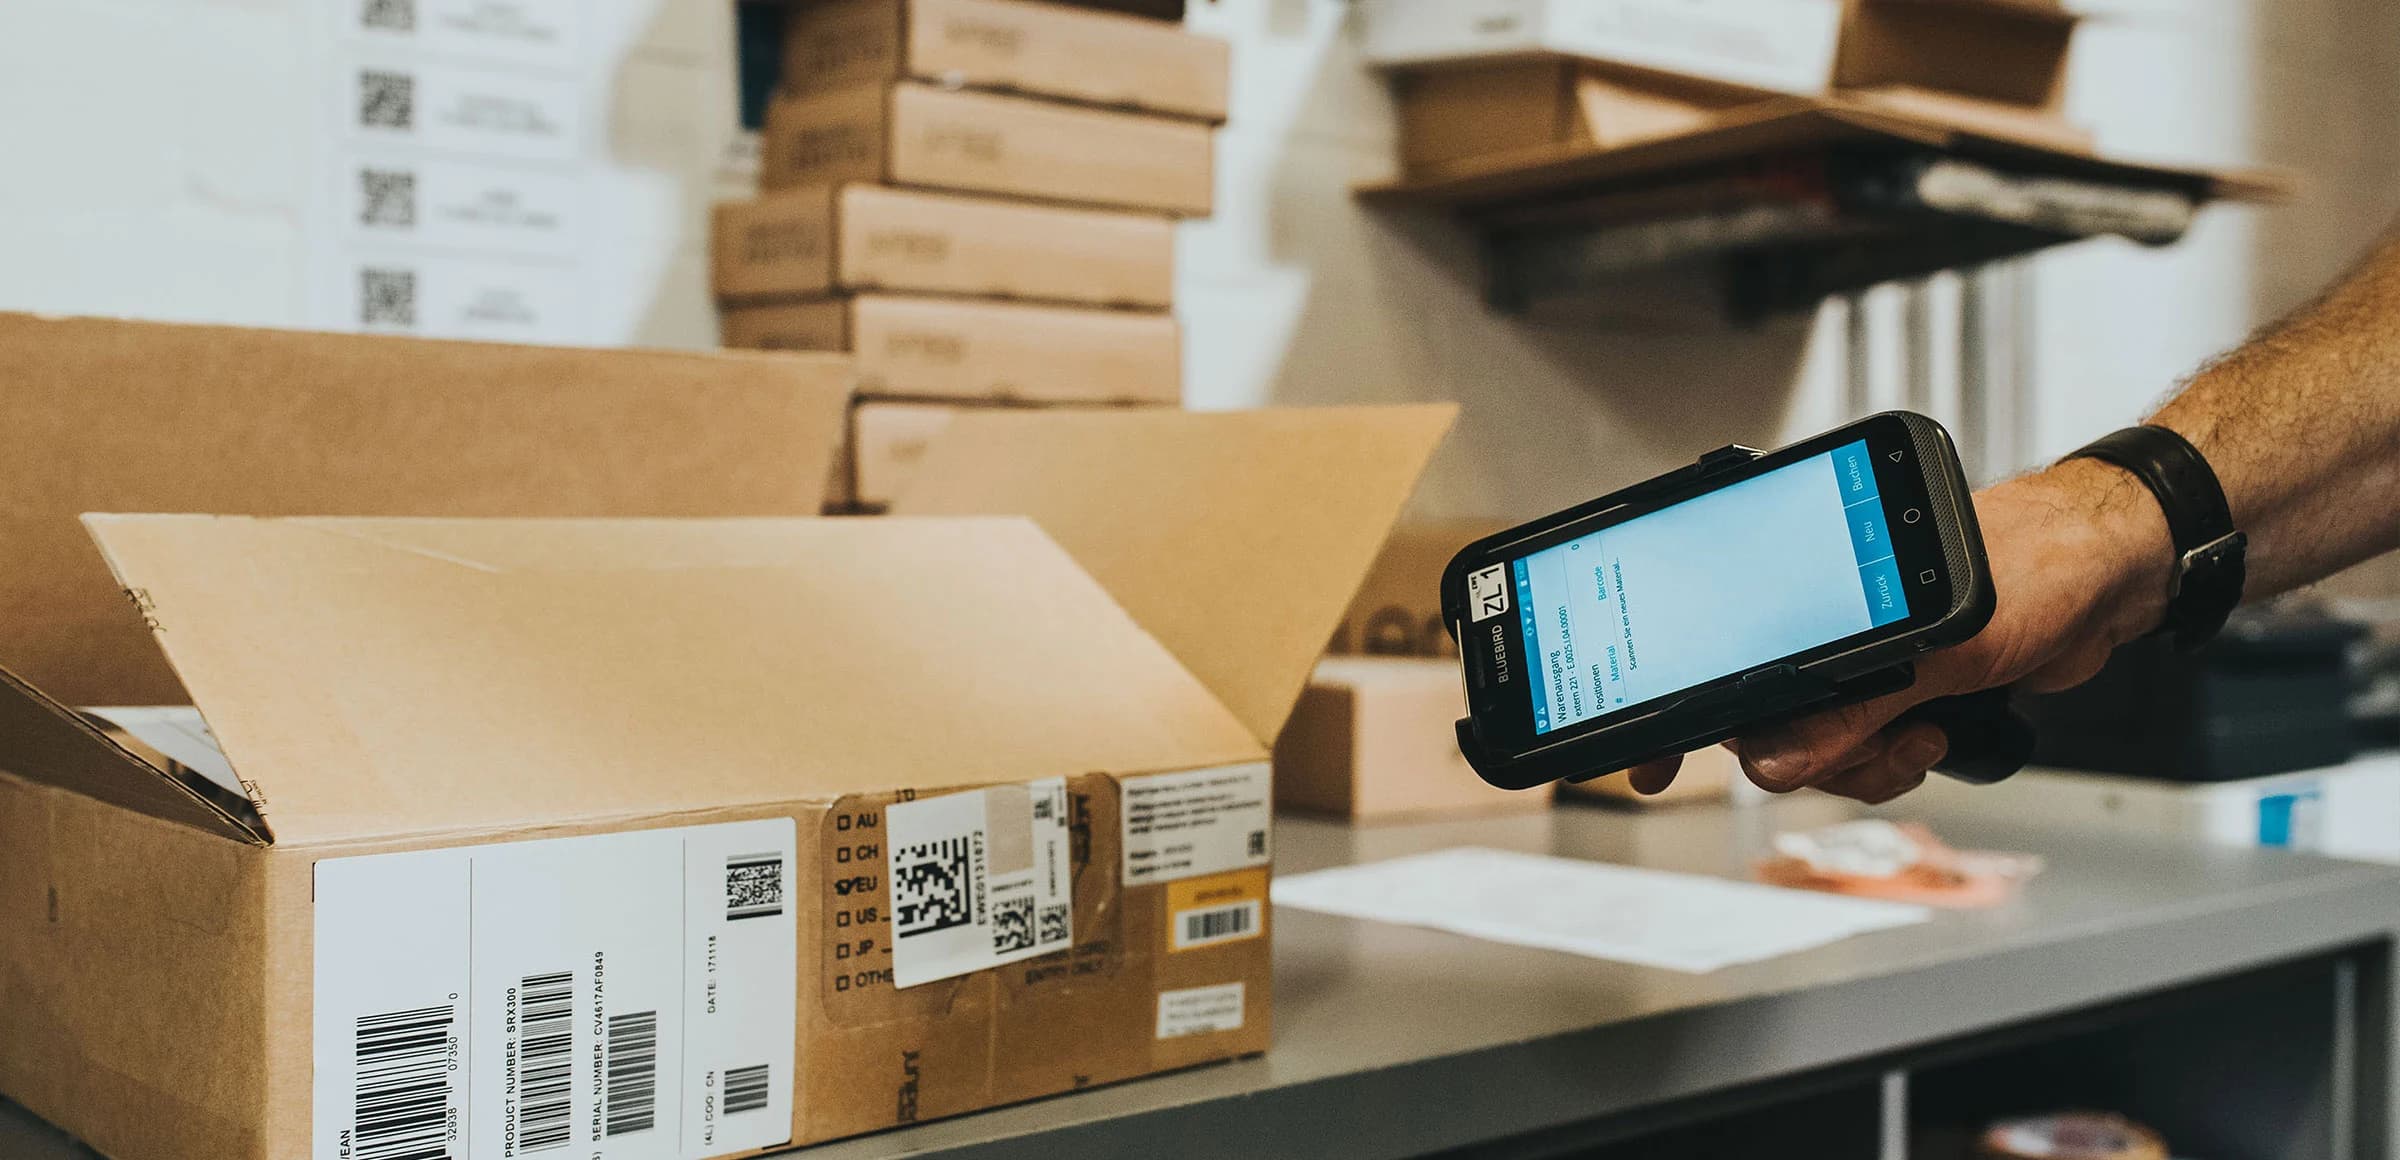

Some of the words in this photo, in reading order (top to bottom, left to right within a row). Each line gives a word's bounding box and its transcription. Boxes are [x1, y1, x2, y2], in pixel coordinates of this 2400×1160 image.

[1848, 455, 1863, 492] Buchen
[1864, 521, 1876, 543] Neu
[1480, 567, 1500, 580] 1
[1594, 566, 1607, 601] Barcode
[1483, 584, 1504, 616] ZL
[1619, 592, 1627, 614] neues
[1876, 574, 1893, 609] Zurück
[1624, 627, 1632, 639] Sie
[1491, 624, 1509, 684] BLUEBIRD
[1607, 645, 1620, 682] Material
[1626, 640, 1637, 671] Scannen
[1550, 650, 1567, 723] Warenausgang
[1569, 676, 1578, 691] 221
[1591, 663, 1605, 711] Positionen
[1572, 692, 1583, 717] extern
[856, 813, 878, 829] AU
[856, 844, 879, 861] CH
[856, 876, 878, 892] EU
[856, 907, 877, 924] US
[708, 935, 717, 973] 171118
[856, 939, 874, 956] JP
[449, 992, 459, 1000] 0
[506, 987, 516, 1033] SRX300
[594, 951, 604, 1036] CV4617AF0849
[707, 980, 716, 1014] DATE:
[447, 1036, 458, 1071] 07350
[506, 1037, 516, 1094] NUMBER:
[593, 1040, 603, 1095] NUMBER:
[706, 1070, 715, 1087] CN
[447, 1107, 457, 1141] 32938
[505, 1098, 515, 1158] PRODUCT
[592, 1099, 602, 1141] SERIAL
